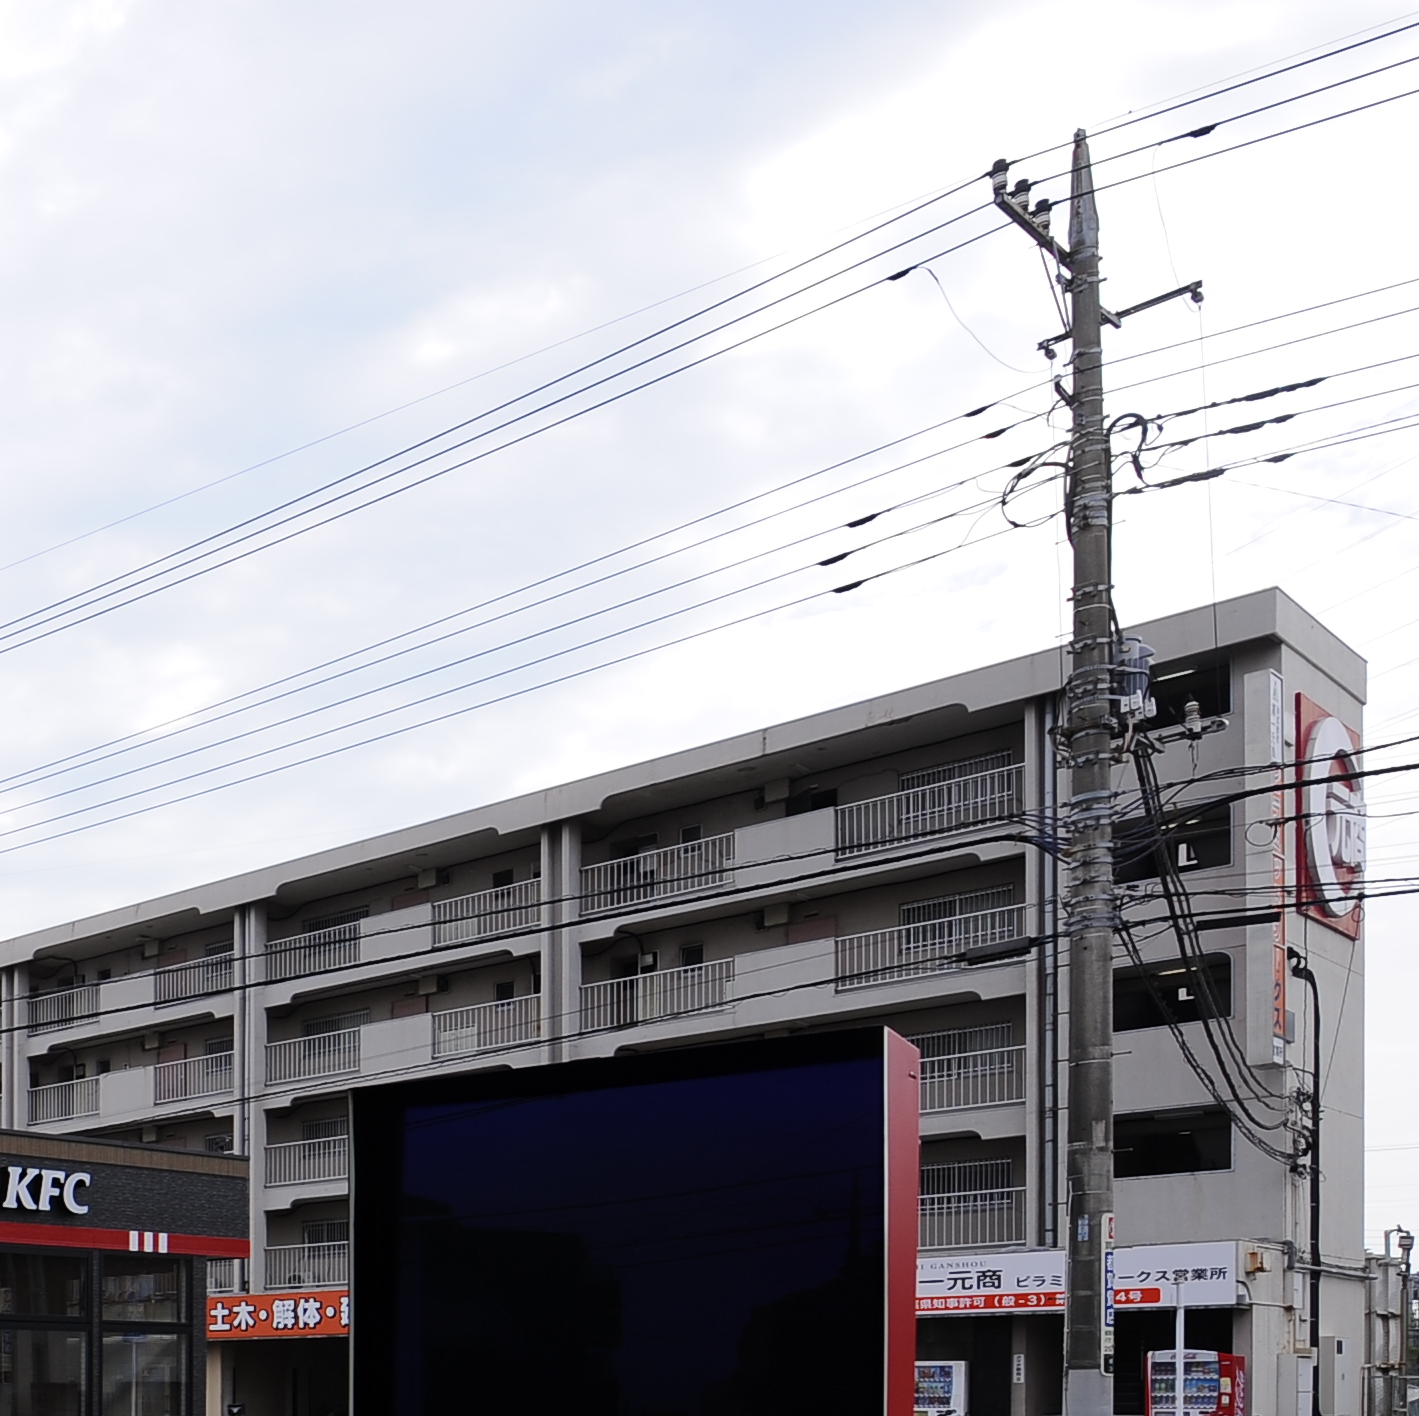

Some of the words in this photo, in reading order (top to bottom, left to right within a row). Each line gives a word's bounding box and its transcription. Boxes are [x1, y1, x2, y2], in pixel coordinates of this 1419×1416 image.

[2, 1166, 91, 1214] KFC
[930, 1260, 987, 1270] GANSHOU
[918, 1269, 1003, 1290] 一元商
